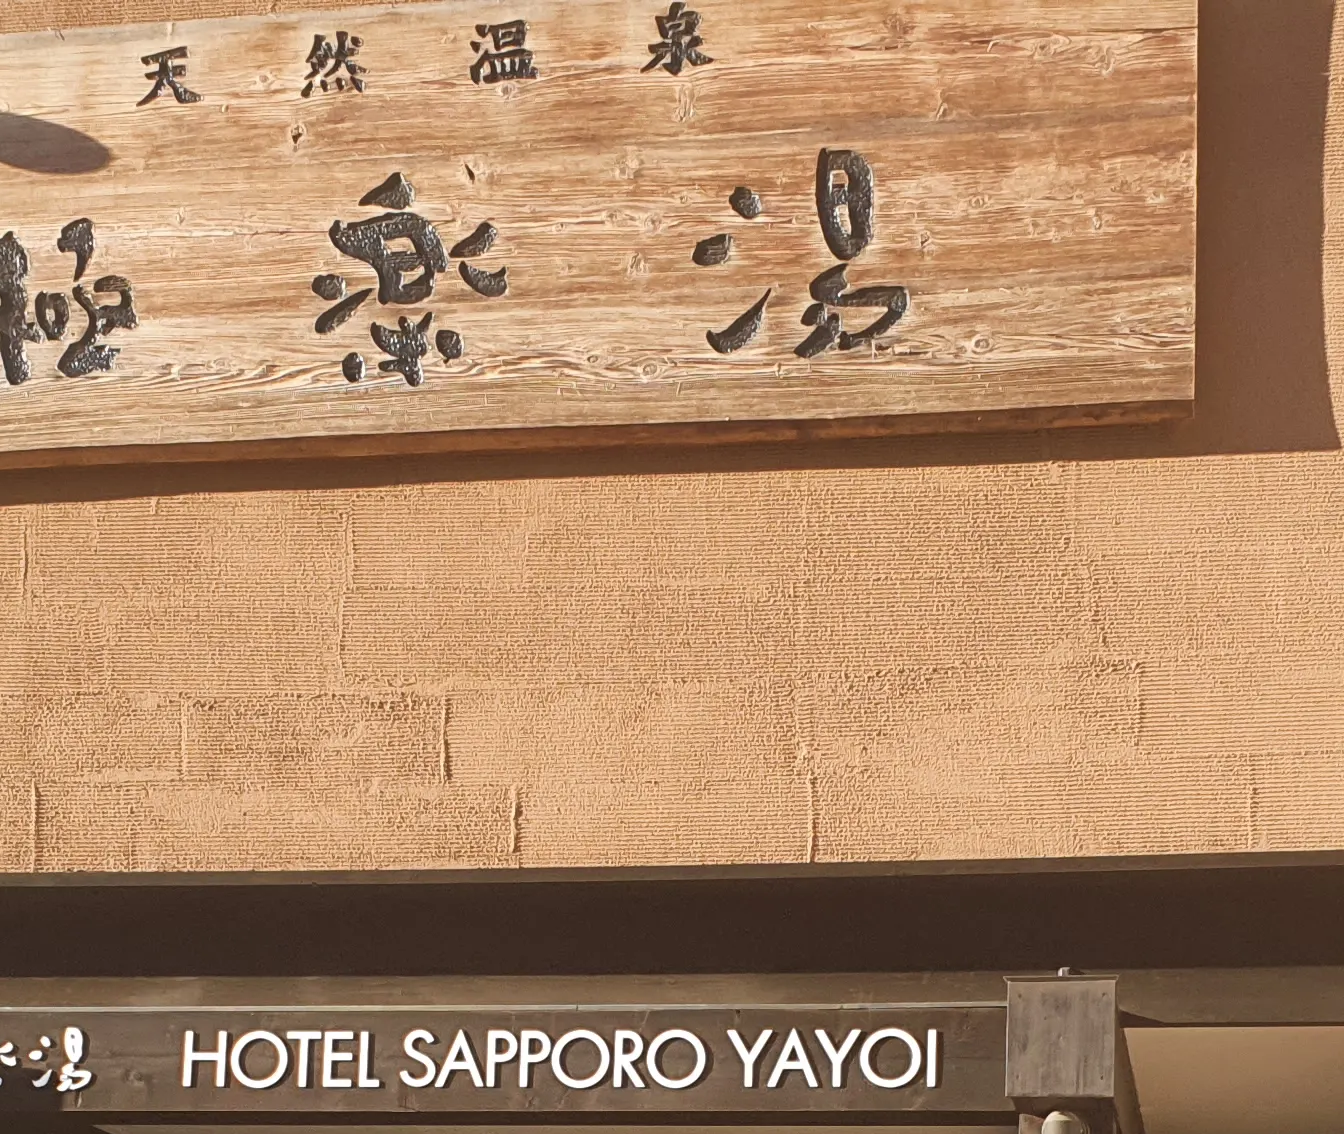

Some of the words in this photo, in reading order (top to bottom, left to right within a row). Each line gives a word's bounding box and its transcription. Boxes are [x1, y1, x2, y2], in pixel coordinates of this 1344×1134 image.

[139, 4, 714, 106] 天然温泉
[182, 1029, 381, 1090] HOTEL
[399, 1028, 707, 1090] SAPPORO
[726, 1028, 937, 1089] YAYOI
